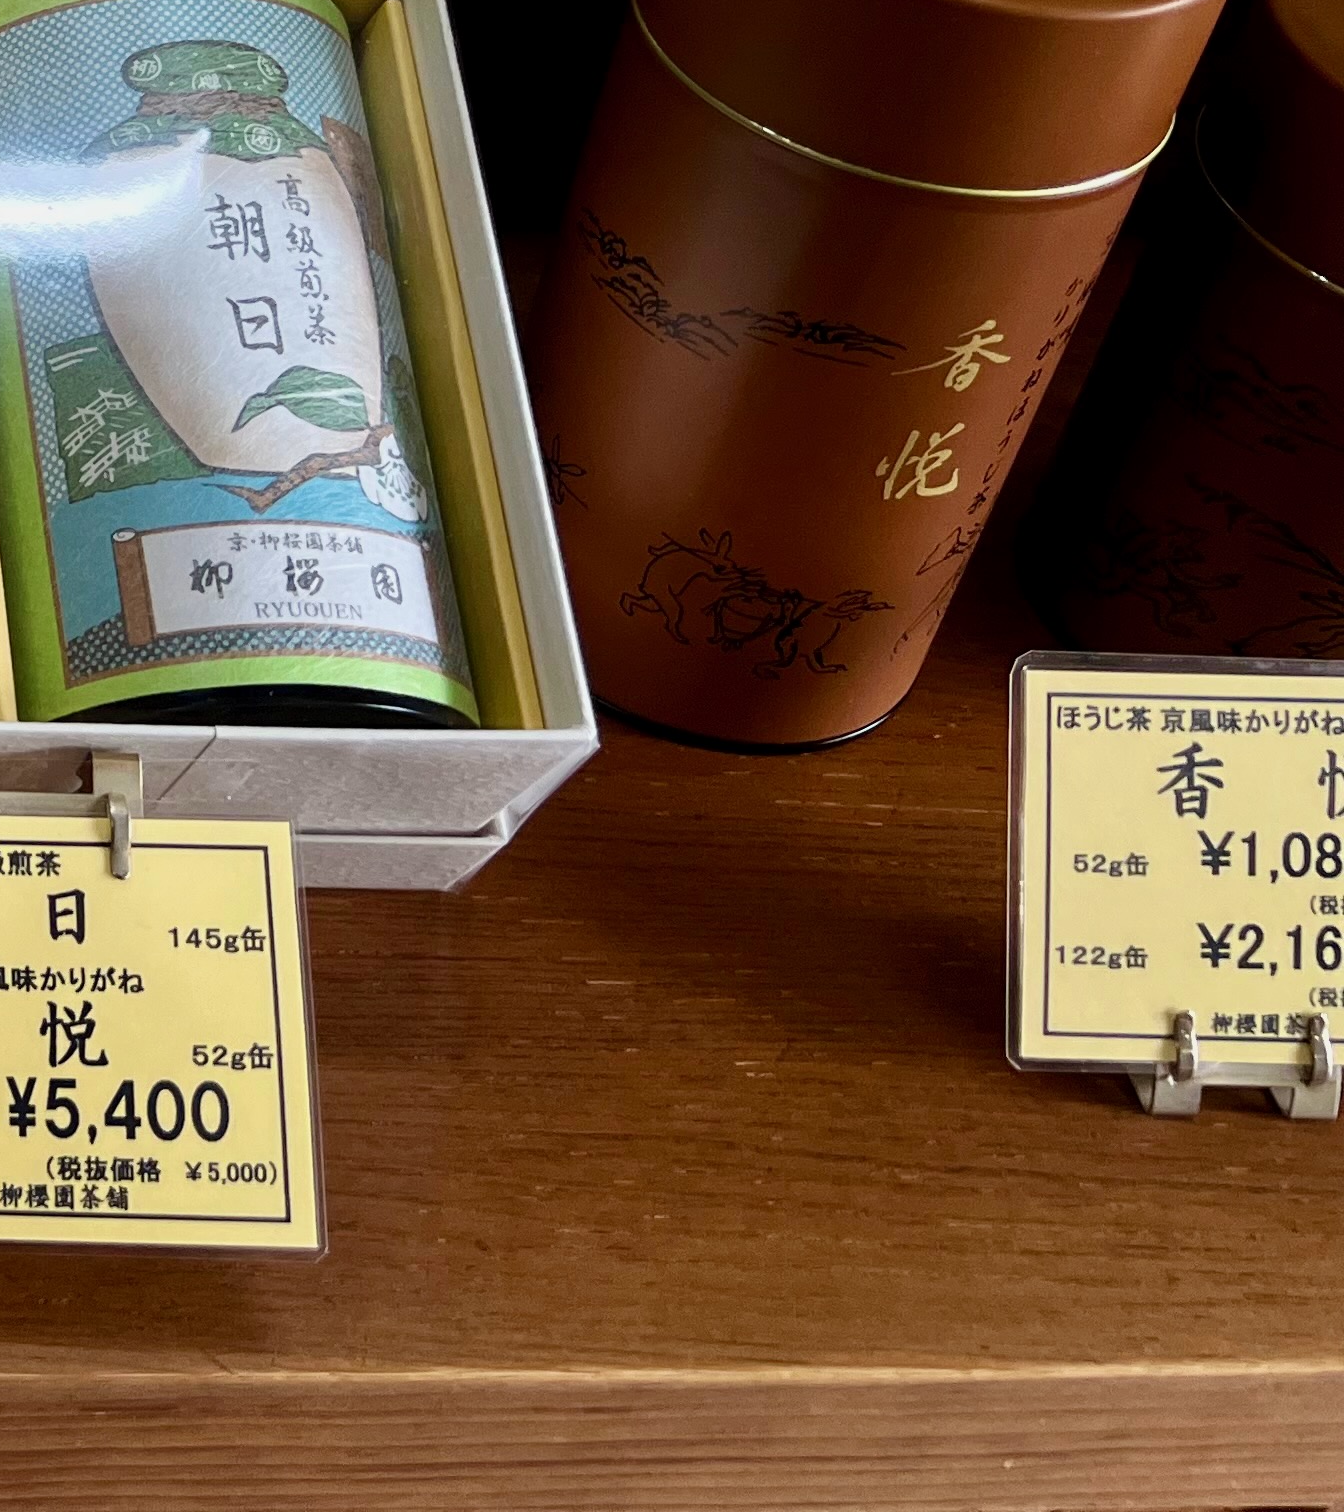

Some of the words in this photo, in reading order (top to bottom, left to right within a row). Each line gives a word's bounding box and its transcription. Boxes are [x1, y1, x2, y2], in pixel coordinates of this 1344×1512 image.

[275, 173, 338, 347] 高級煎茶
[204, 193, 285, 356] 朝日
[874, 319, 1012, 501] 香悦
[253, 600, 364, 622] RYUOUEN
[1055, 705, 1151, 732] ほうじ茶
[1072, 852, 1149, 878] 52g缶
[1310, 894, 1344, 916] (税
[167, 925, 267, 954] 145g缶
[1055, 945, 1149, 970] 122g缶
[1309, 985, 1344, 1008] (税
[1211, 1011, 1310, 1037] 柳櫻園茶
[191, 1042, 275, 1071] 52g缶
[6, 1075, 231, 1146] ¥5,400
[45, 1155, 162, 1182] (税抜価格
[184, 1159, 278, 1185] ¥5,000)
